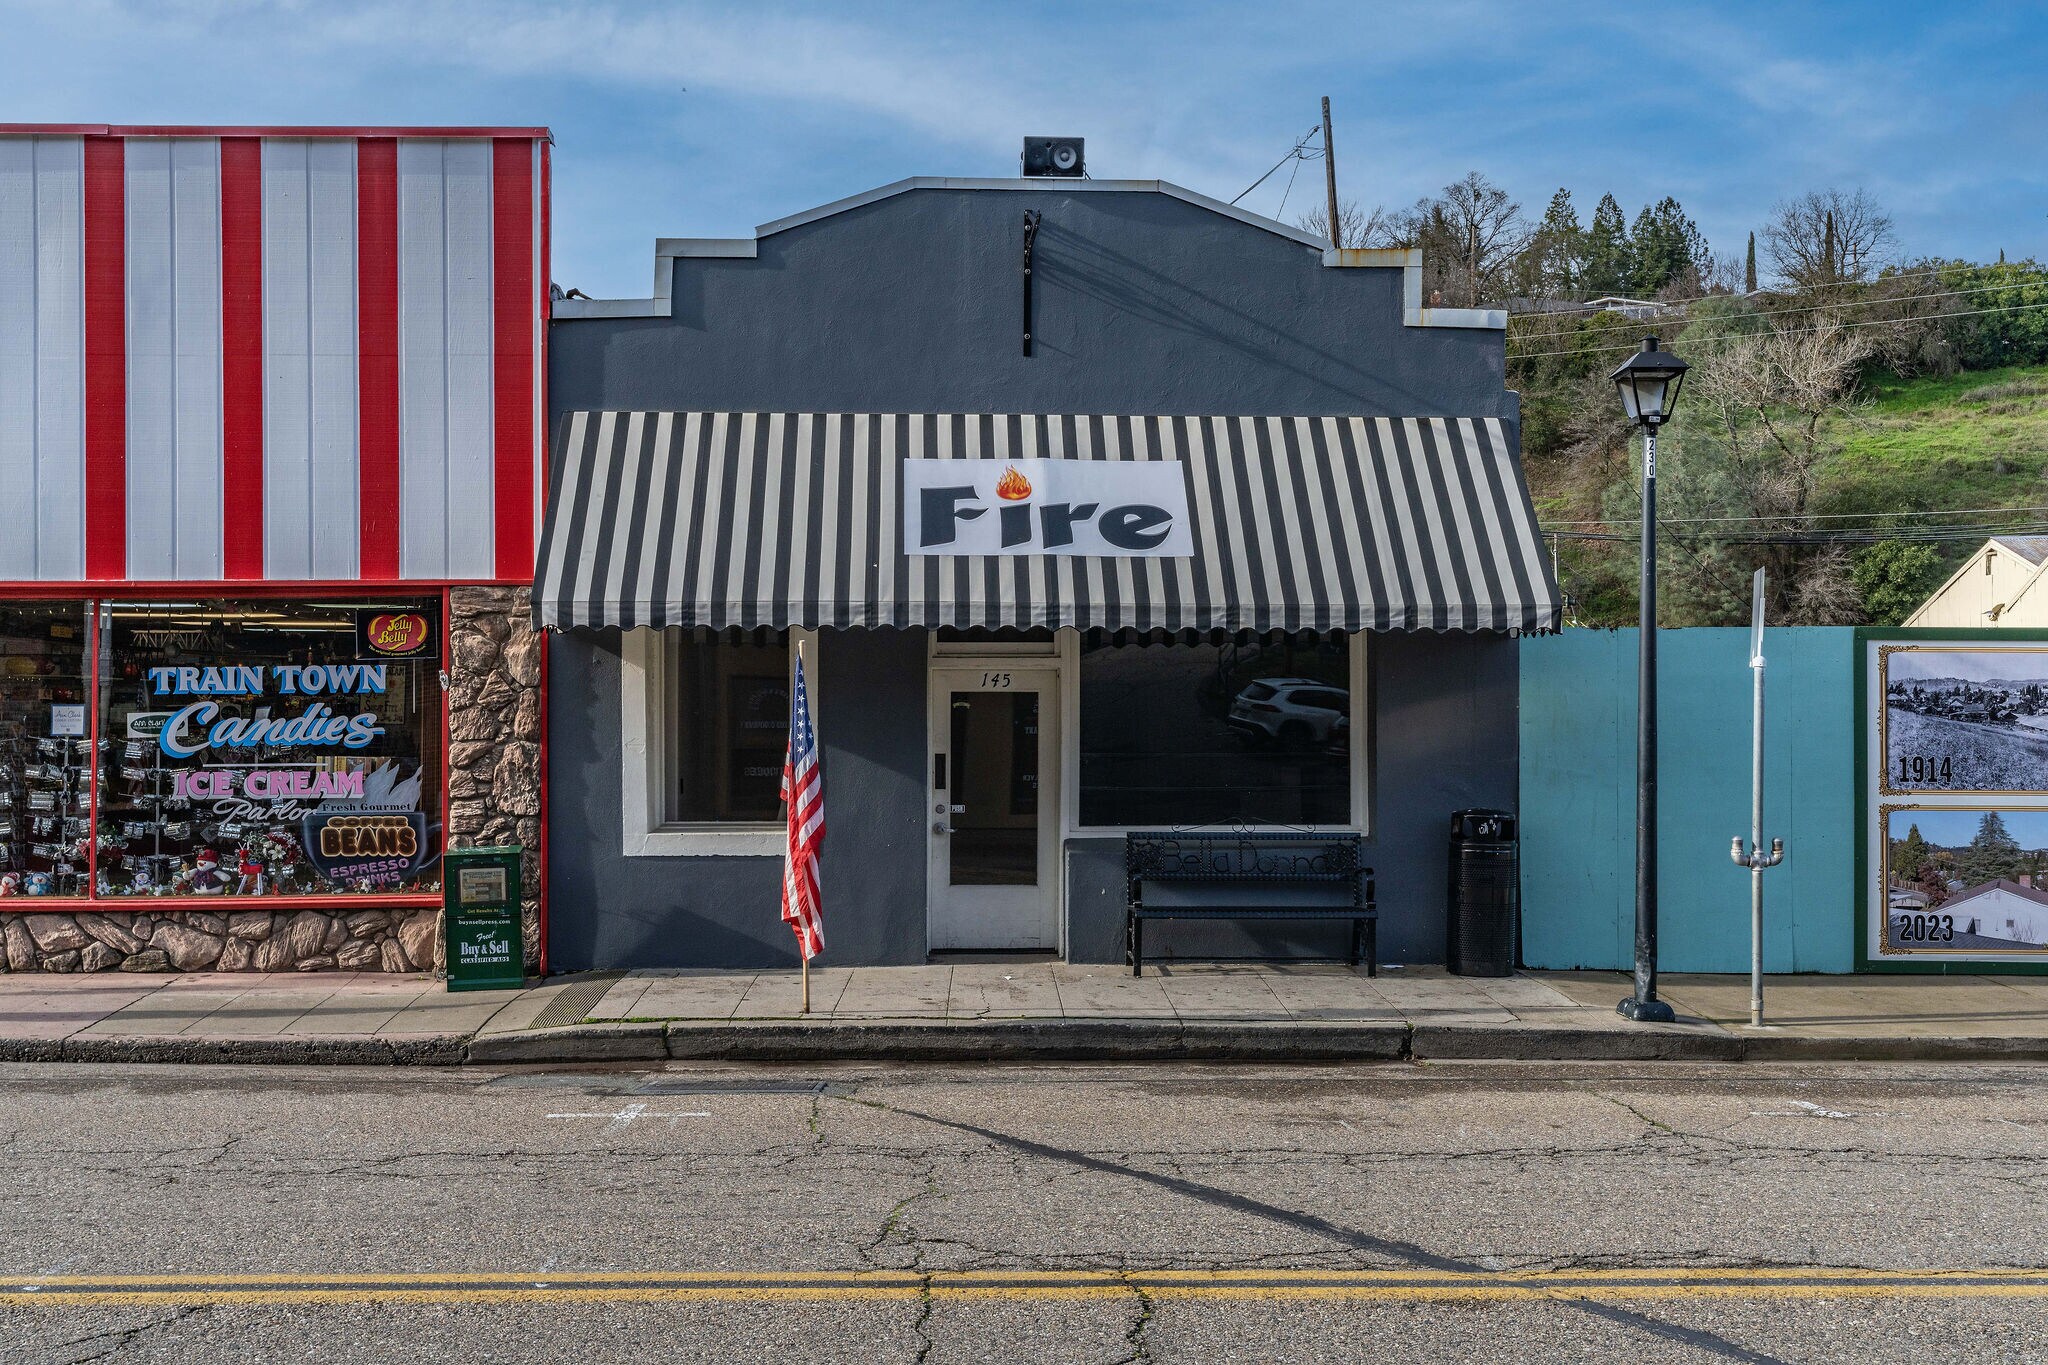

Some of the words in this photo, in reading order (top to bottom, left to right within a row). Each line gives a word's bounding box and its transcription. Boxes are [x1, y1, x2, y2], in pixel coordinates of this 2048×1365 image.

[920, 485, 1174, 550] Fire
[387, 614, 412, 633] Jelly
[377, 630, 407, 651] Belly
[149, 666, 264, 695] TRAIN
[273, 664, 388, 694] TOWN
[981, 672, 1011, 688] 145
[159, 701, 386, 759] Candies
[1899, 756, 1952, 782] 1914
[173, 771, 234, 800] ICE
[244, 770, 365, 799] CREAM
[212, 798, 318, 826] Parlor
[322, 803, 356, 811] Fresh
[360, 803, 412, 811] Gourmet
[327, 816, 409, 828] COFFEE
[321, 826, 418, 857] BEANS
[330, 858, 410, 878] ESPRESSO
[1161, 839, 1229, 873] Bella
[1238, 840, 1327, 873] Donna
[1900, 914, 1954, 941] 2023
[460, 941, 480, 957] Buy
[481, 944, 488, 955] &
[489, 940, 509, 955] Sell
